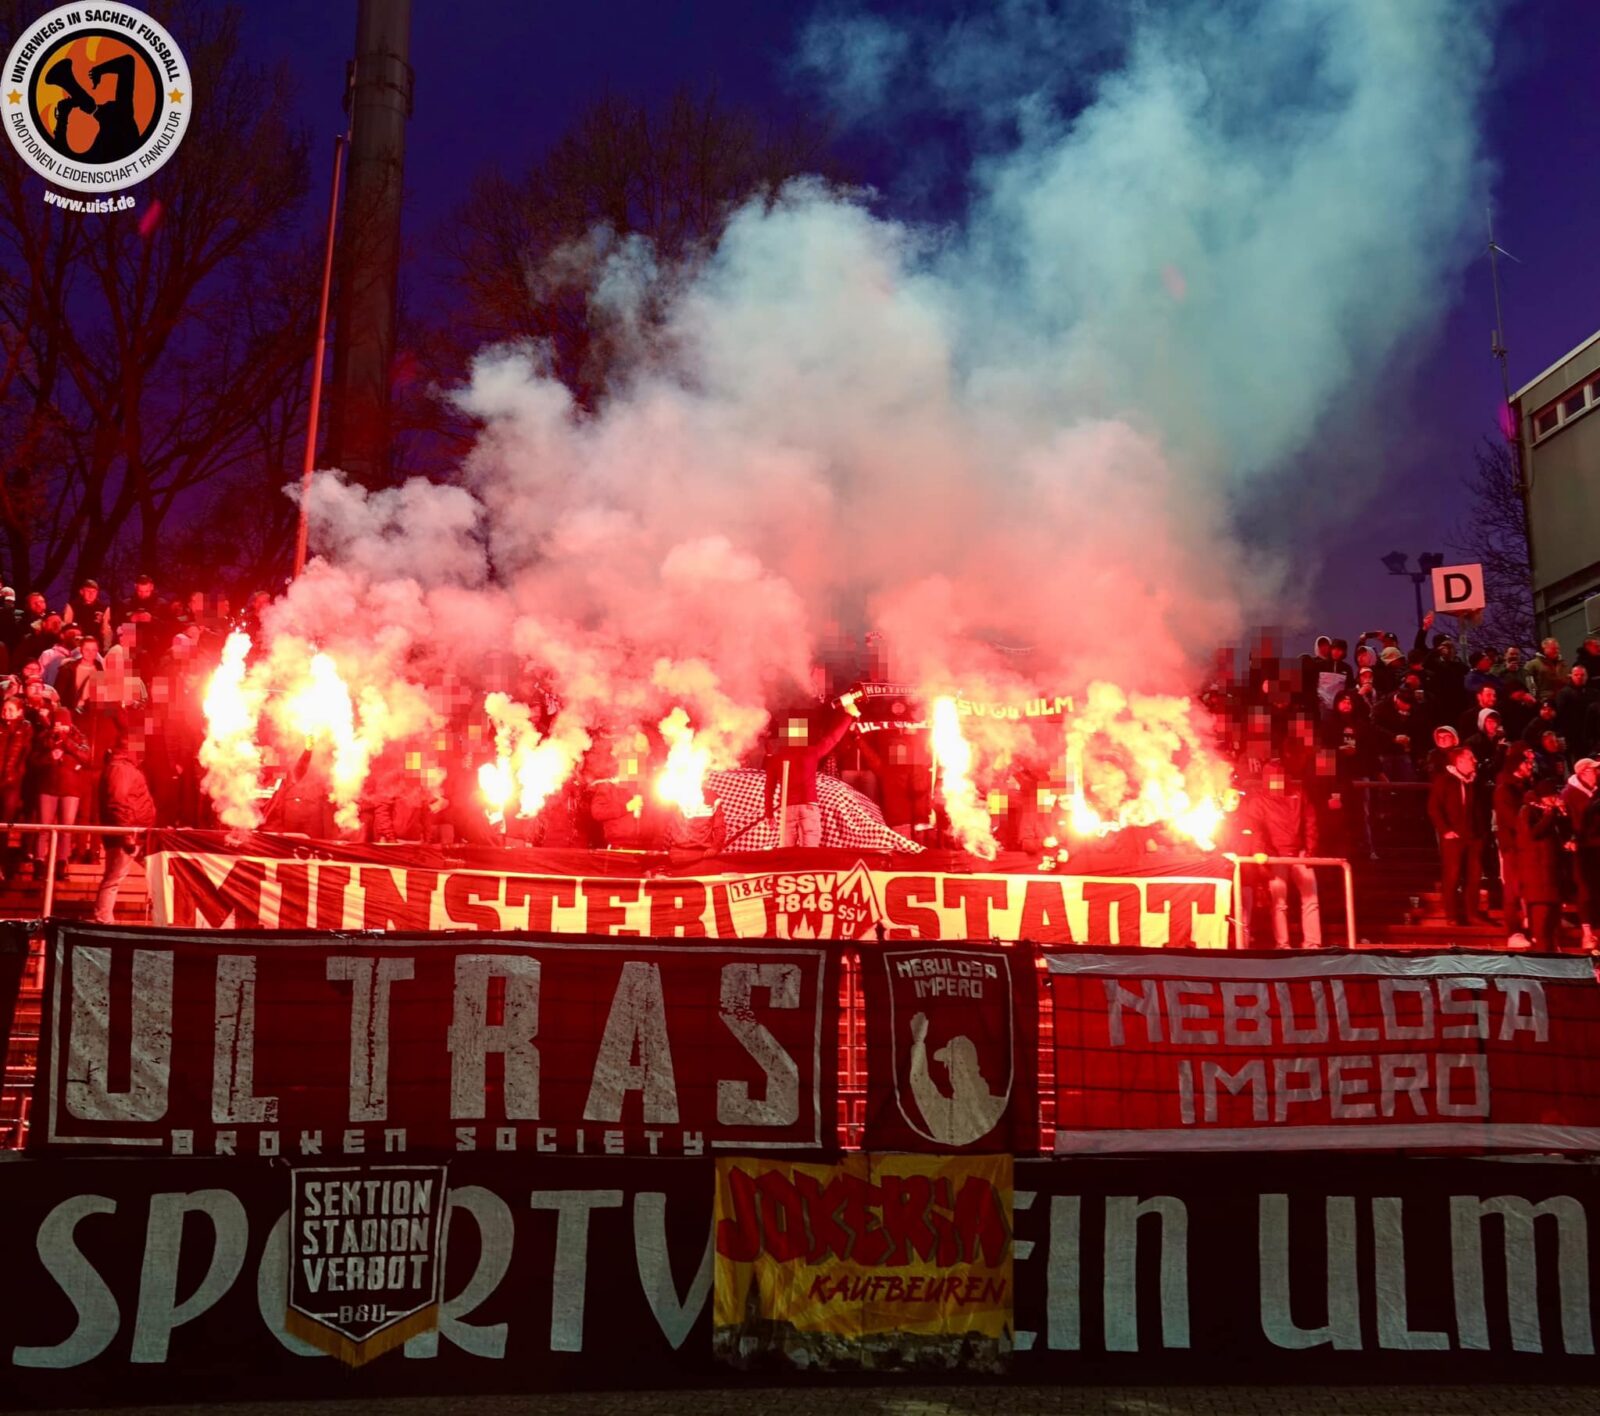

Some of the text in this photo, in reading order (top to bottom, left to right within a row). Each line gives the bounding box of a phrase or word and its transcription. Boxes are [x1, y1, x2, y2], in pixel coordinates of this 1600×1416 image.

[1443, 573, 1472, 603] D
[1025, 696, 1074, 716] ULM
[776, 874, 836, 894] SSV
[775, 893, 834, 912] 1846
[837, 904, 867, 922] SSV
[896, 958, 998, 978] NEBULOSA
[914, 976, 983, 998] IMPERO
[1102, 976, 1549, 1046] NEBULOSA
[66, 945, 801, 1126] ULTRAS
[1177, 1053, 1490, 1124] IMPERO
[171, 1126, 704, 1157] BROKEN SOCIETY
[304, 1179, 433, 1216] SEKTION
[302, 1217, 430, 1255] STADION
[302, 1254, 429, 1293] VERBOT
[807, 1274, 1006, 1306] KAUFBEUREN
